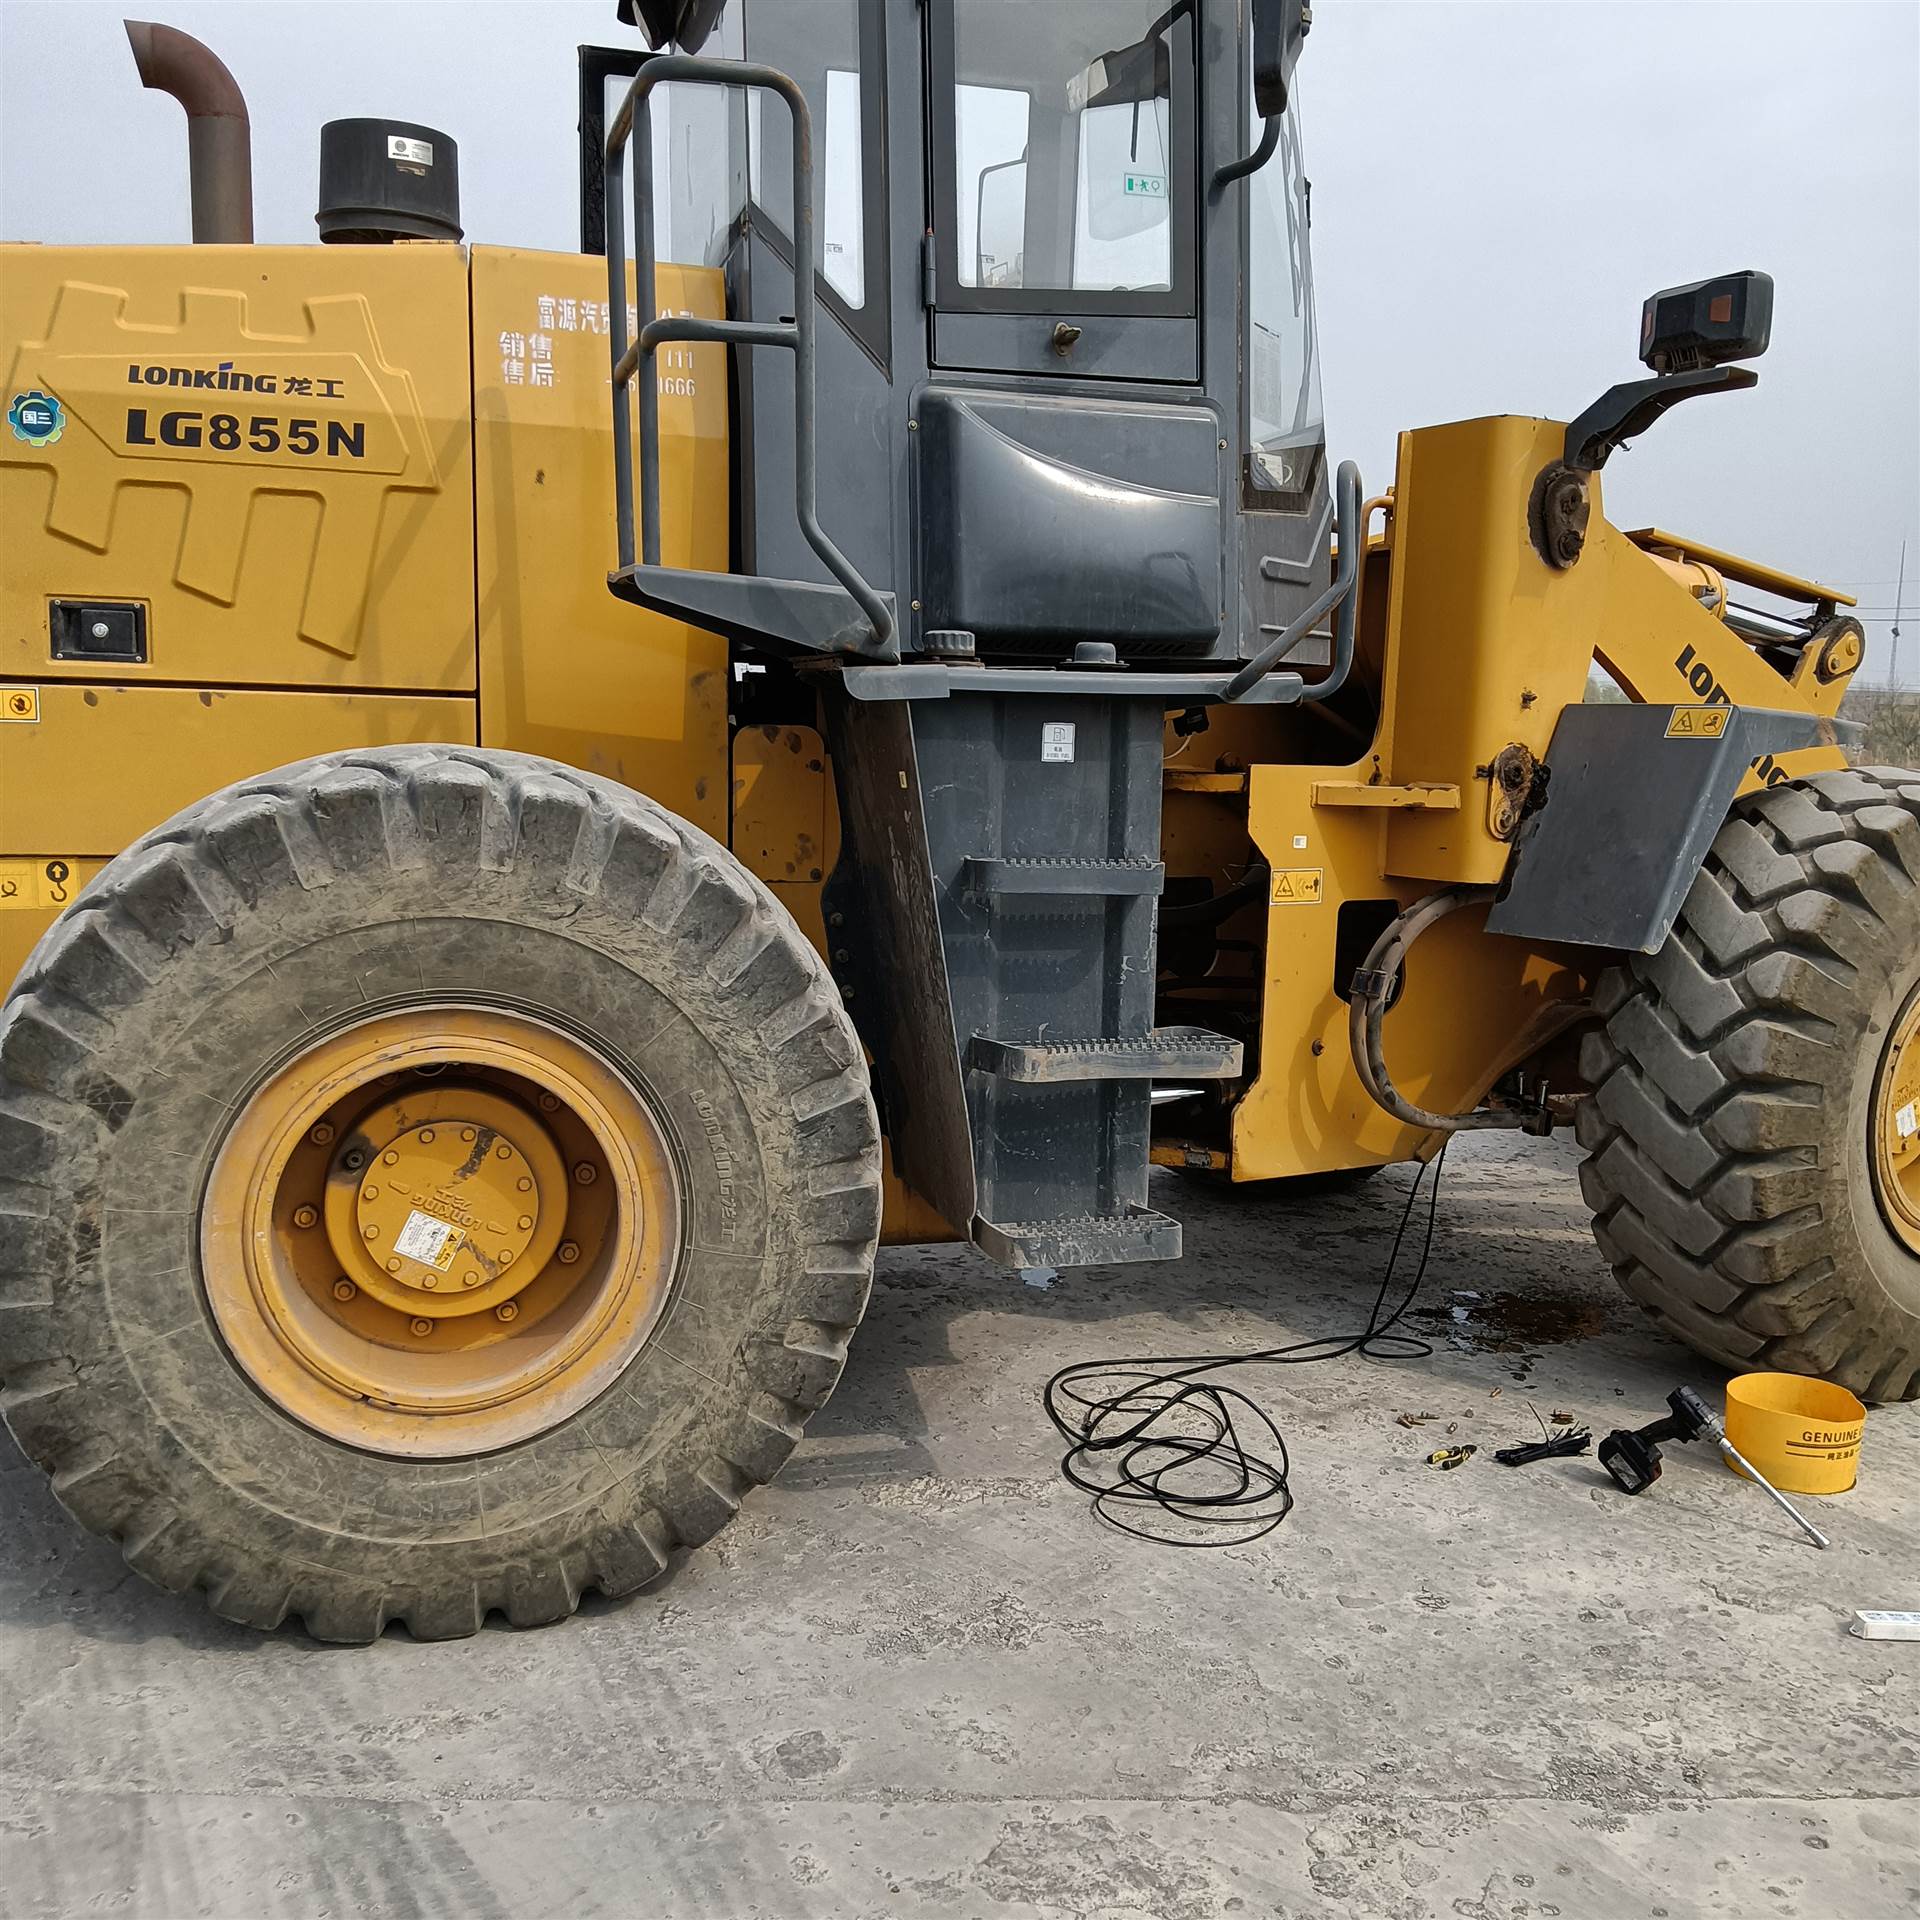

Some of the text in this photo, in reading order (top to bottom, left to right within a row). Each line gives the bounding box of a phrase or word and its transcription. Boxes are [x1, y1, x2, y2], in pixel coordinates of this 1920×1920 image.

[283, 376, 345, 398] 龙工
[22, 410, 53, 425] 国三
[126, 408, 366, 458] LG855N
[1802, 1428, 1859, 1443] GENUINE
